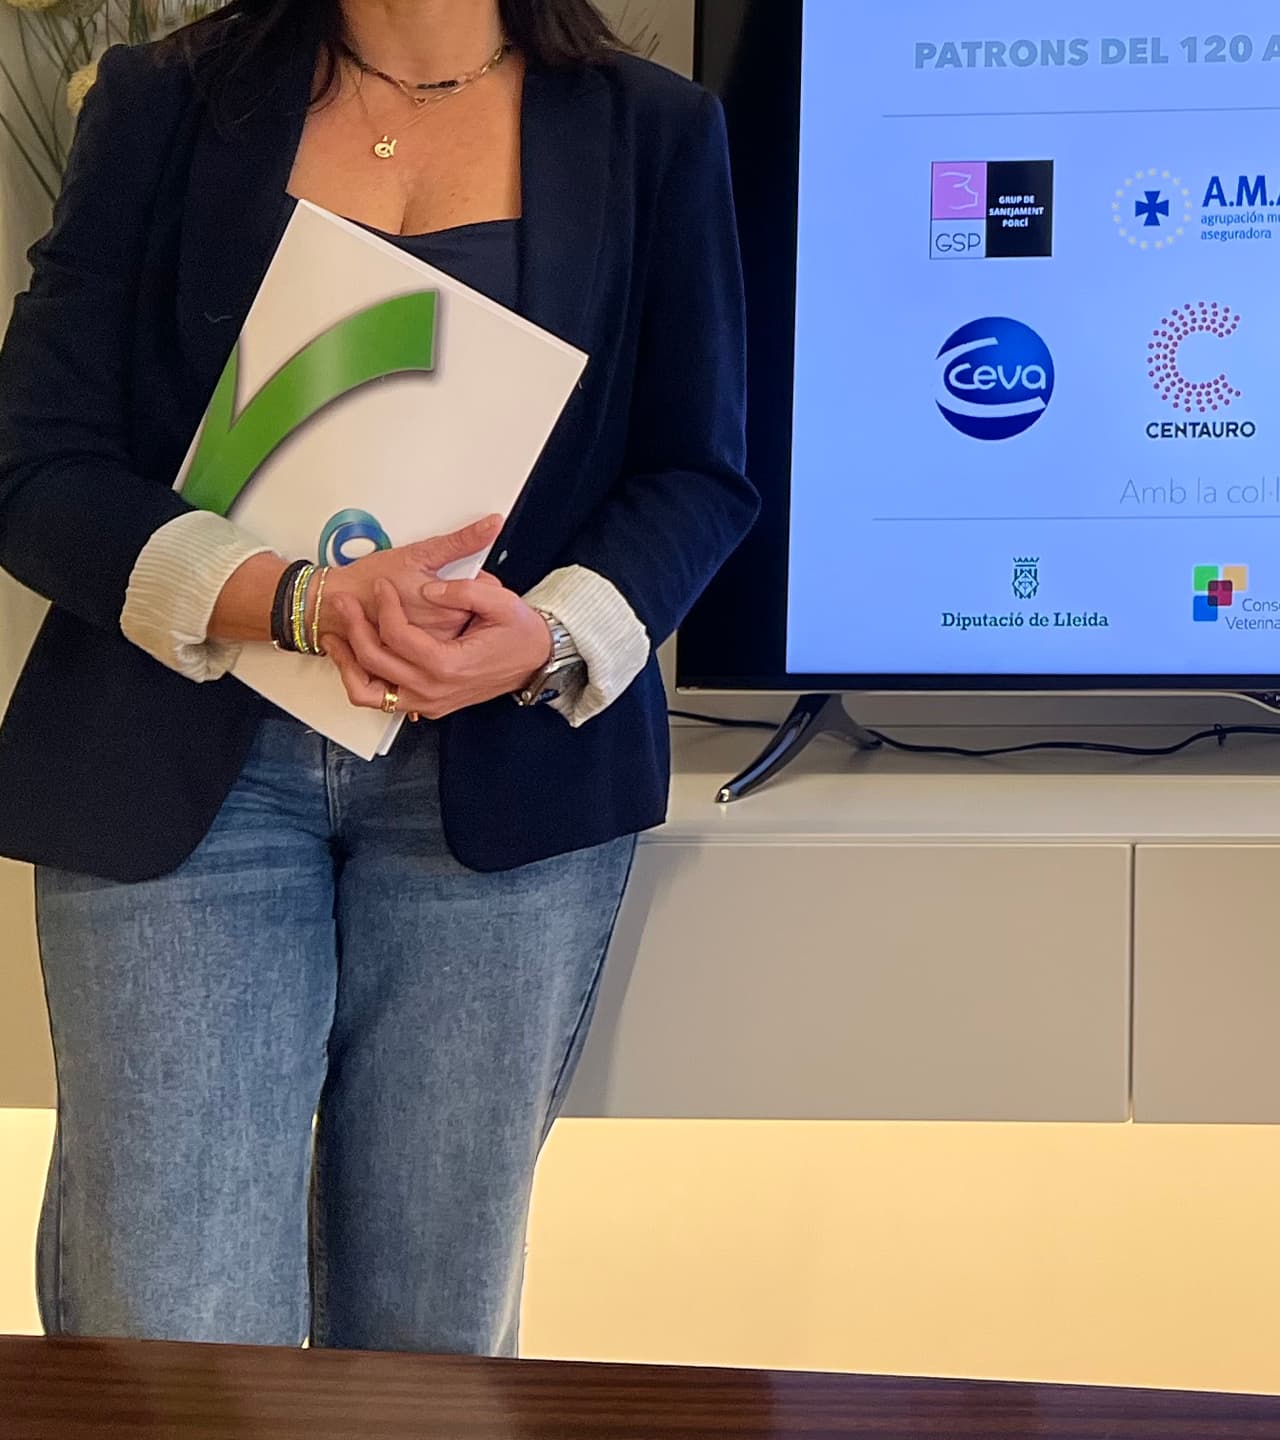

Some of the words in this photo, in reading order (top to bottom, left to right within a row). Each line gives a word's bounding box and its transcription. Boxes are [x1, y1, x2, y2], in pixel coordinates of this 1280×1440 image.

[915, 39, 1088, 69] PATRONS
[1100, 37, 1169, 65] DEL
[1181, 34, 1253, 63] 120
[998, 195, 1022, 204] GRUP
[1023, 195, 1035, 204] DE
[989, 207, 1044, 217] SANEJAMENT
[1200, 210, 1264, 228] agrupación
[1002, 218, 1029, 227] PORCÍ
[936, 233, 981, 252] GSP
[1200, 227, 1272, 242] aseguradora
[948, 362, 1047, 391] ceva
[1145, 421, 1256, 439] CENTAURO
[1120, 477, 1186, 505] Amb
[1196, 477, 1217, 504] la
[941, 612, 1024, 630] Diputació
[1029, 612, 1049, 627] de
[1053, 612, 1109, 627] Lleida
